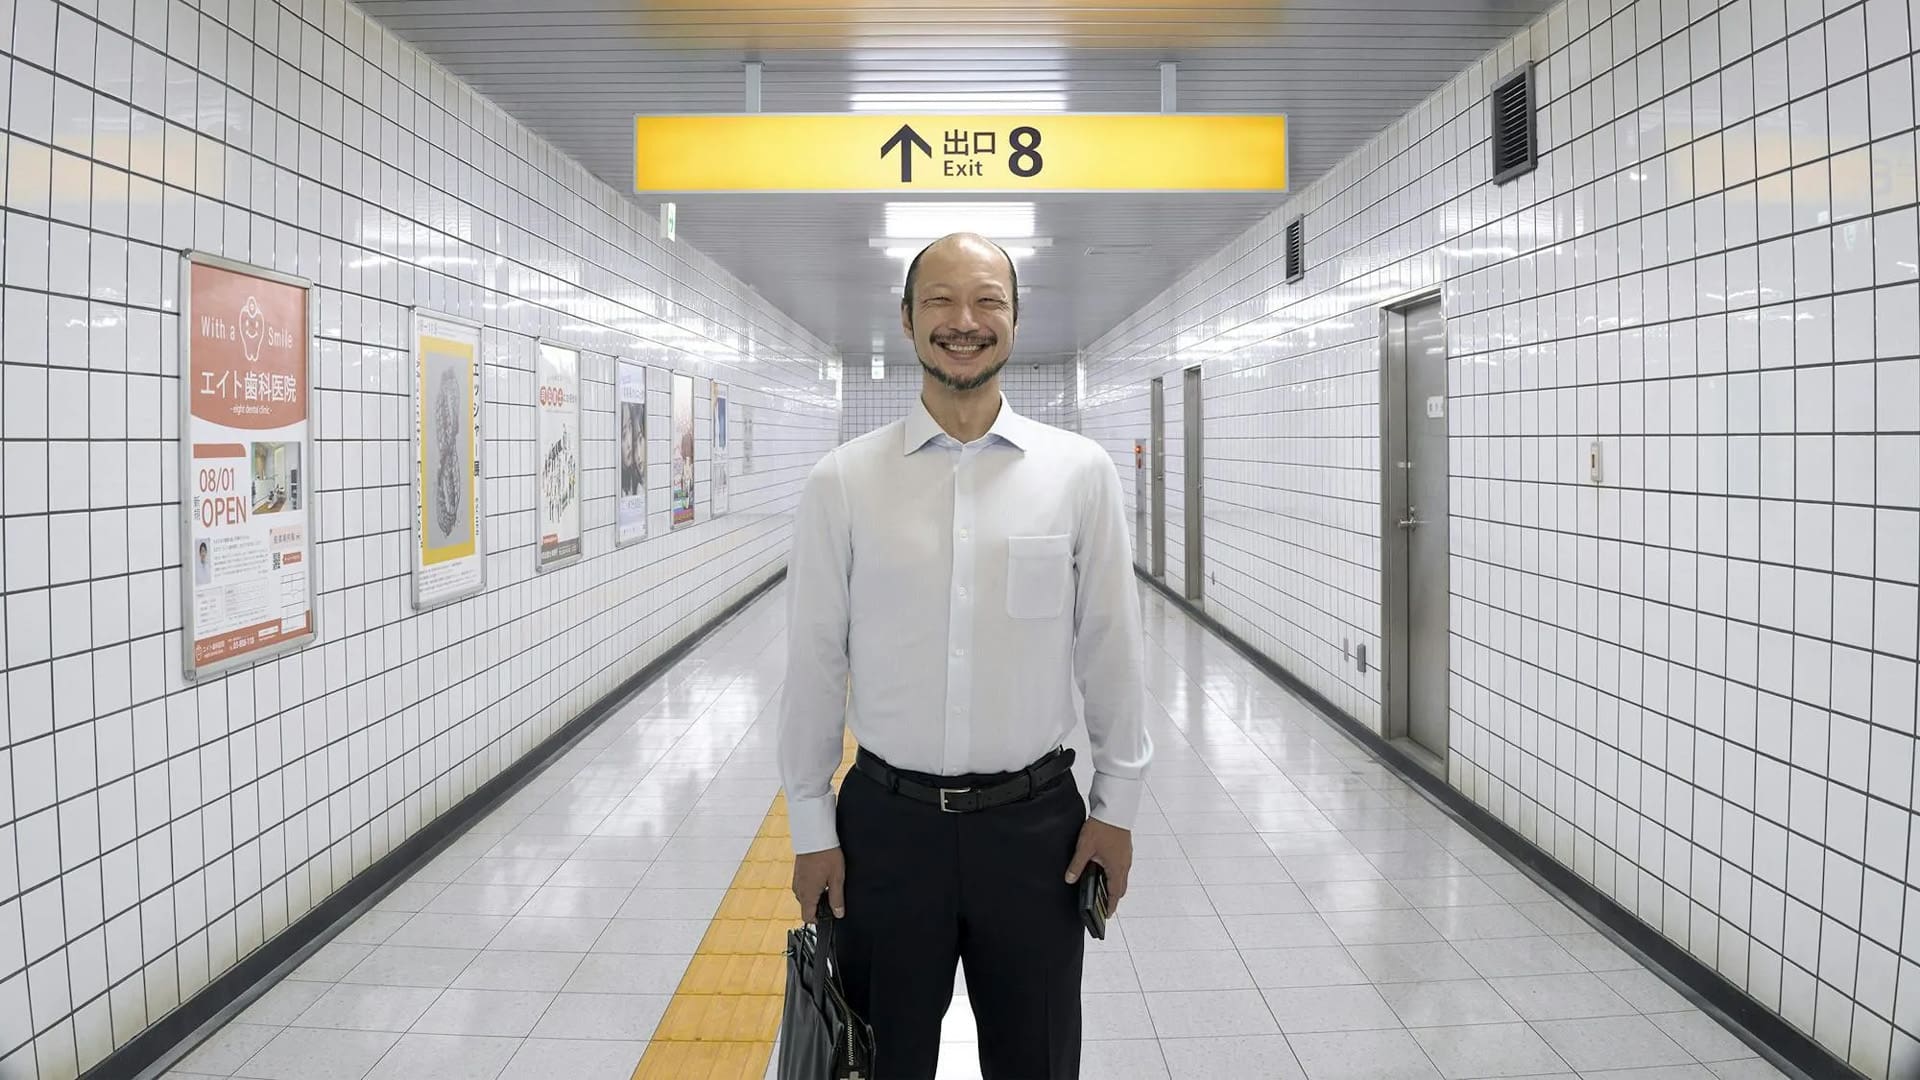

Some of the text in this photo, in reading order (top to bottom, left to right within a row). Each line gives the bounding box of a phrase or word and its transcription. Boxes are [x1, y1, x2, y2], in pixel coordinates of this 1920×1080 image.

[944, 129, 995, 156] 出口
[1008, 126, 1043, 177] 8
[944, 159, 983, 176] Exit
[201, 316, 292, 348] With a Smile
[200, 370, 296, 402] エイト歯科医院
[200, 467, 235, 493] 08/01
[202, 496, 246, 528] OPEN
